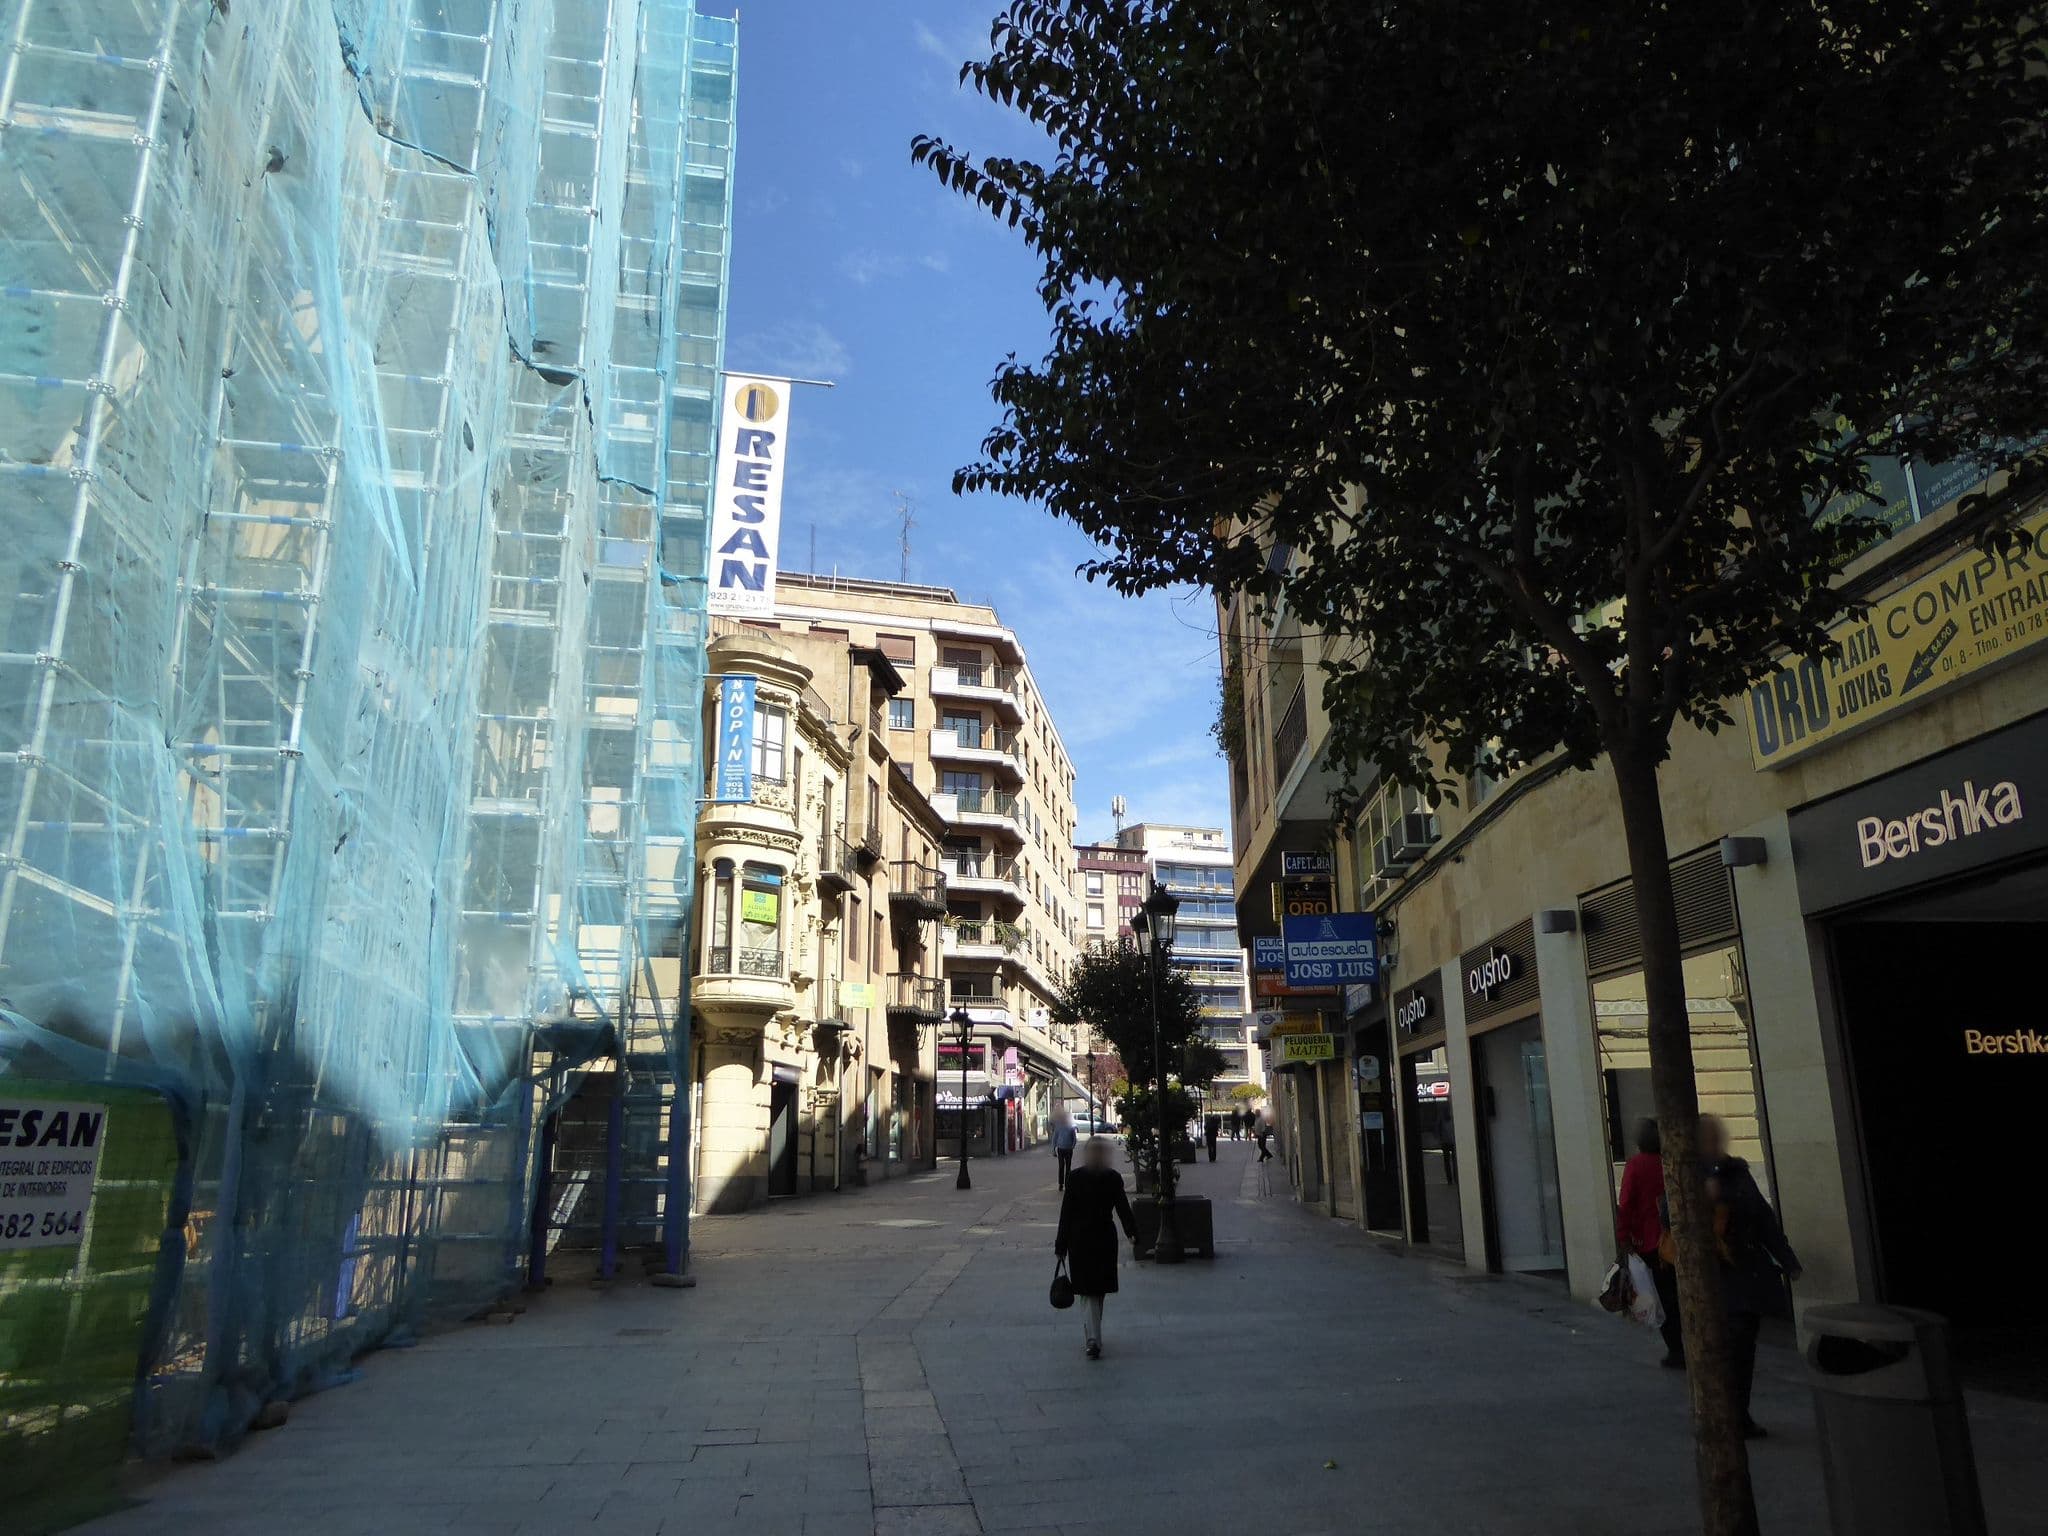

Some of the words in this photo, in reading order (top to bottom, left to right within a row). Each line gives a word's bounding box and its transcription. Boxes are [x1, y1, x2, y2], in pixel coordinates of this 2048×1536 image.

[710, 591, 728, 600] 923
[1959, 650, 1967, 664] 8
[2005, 620, 2026, 642] 610
[2027, 613, 2042, 631] 78
[1829, 624, 1881, 679] PLATA
[1836, 663, 1892, 719] JOYAS
[1751, 655, 1830, 757] ORO
[1857, 780, 2023, 868] Bershka
[1288, 900, 1328, 916] ORO
[1291, 942, 1319, 957] auto
[1321, 940, 1368, 956] escuela
[1290, 962, 1333, 979] JOSE
[1337, 961, 1375, 978] LUIS
[1469, 947, 1511, 1002] oysho
[1398, 990, 1426, 1033] oysho
[1285, 1035, 1331, 1046] PELUQUERIA
[1288, 1045, 1328, 1057] MAITE
[942, 1090, 952, 1098] LA
[0, 1160, 34, 1175] TEGRAL
[37, 1161, 50, 1175] DE
[51, 1160, 93, 1175] EDIFICIOS
[3, 1183, 16, 1198] DE
[18, 1181, 67, 1197] INTERIORES
[41, 1210, 82, 1237] 564
